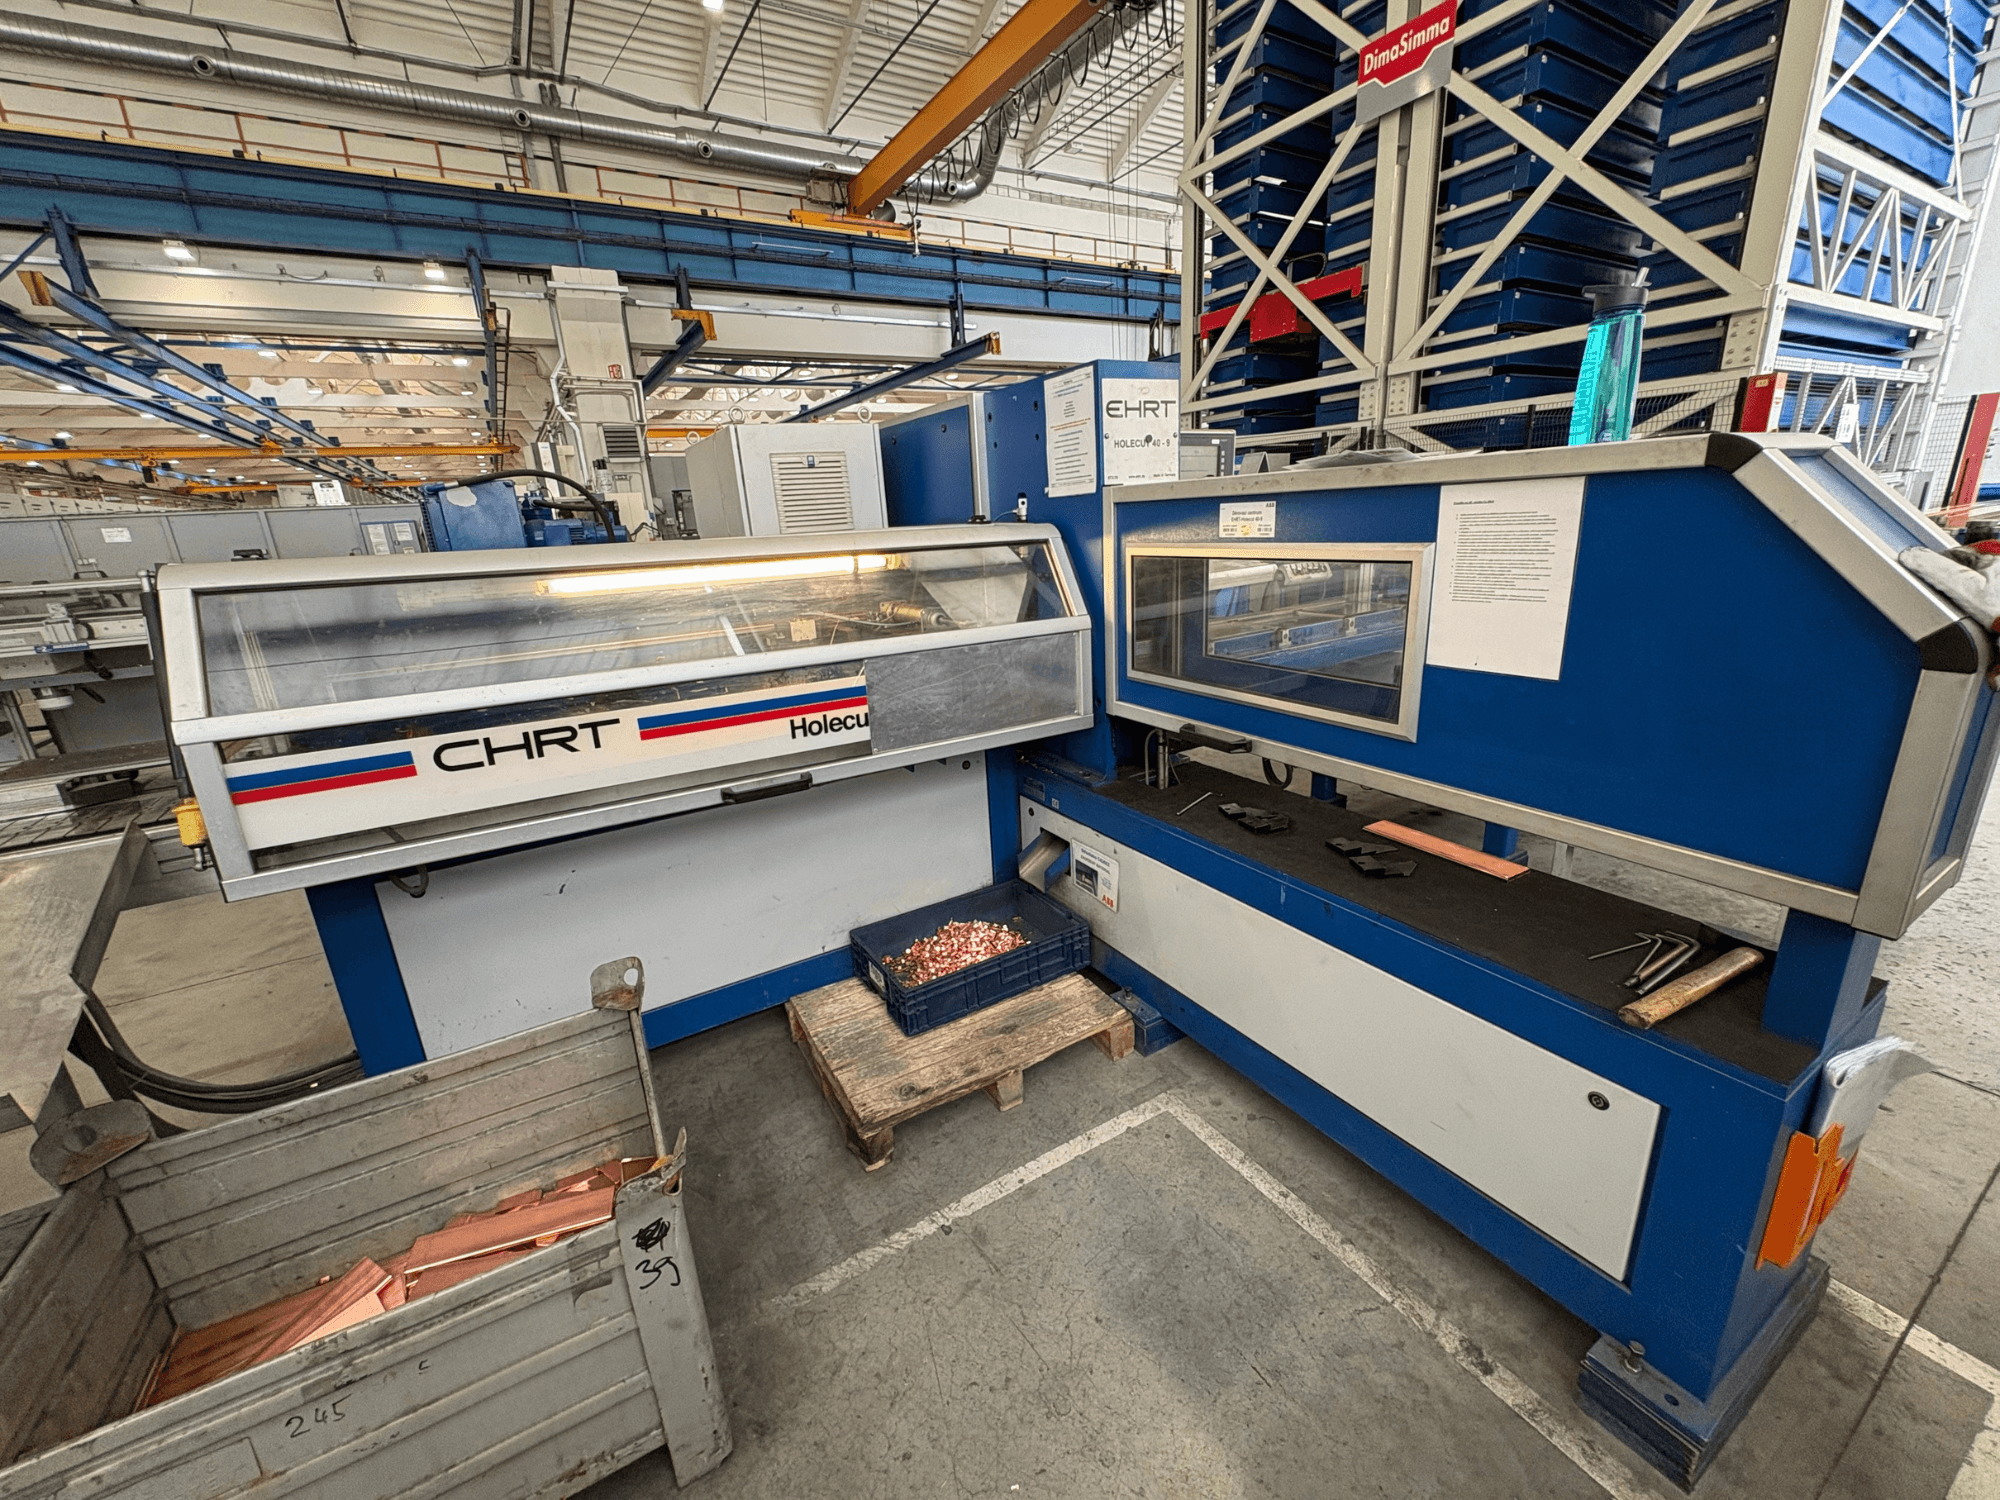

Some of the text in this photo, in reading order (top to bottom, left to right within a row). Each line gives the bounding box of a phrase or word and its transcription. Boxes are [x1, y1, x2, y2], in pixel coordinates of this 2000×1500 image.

[1363, 16, 1450, 76] DimaSimma
[1106, 400, 1176, 418] EHRT
[1152, 439, 1160, 447] 40
[1166, 438, 1170, 447] 9
[285, 1393, 352, 1438] 245
